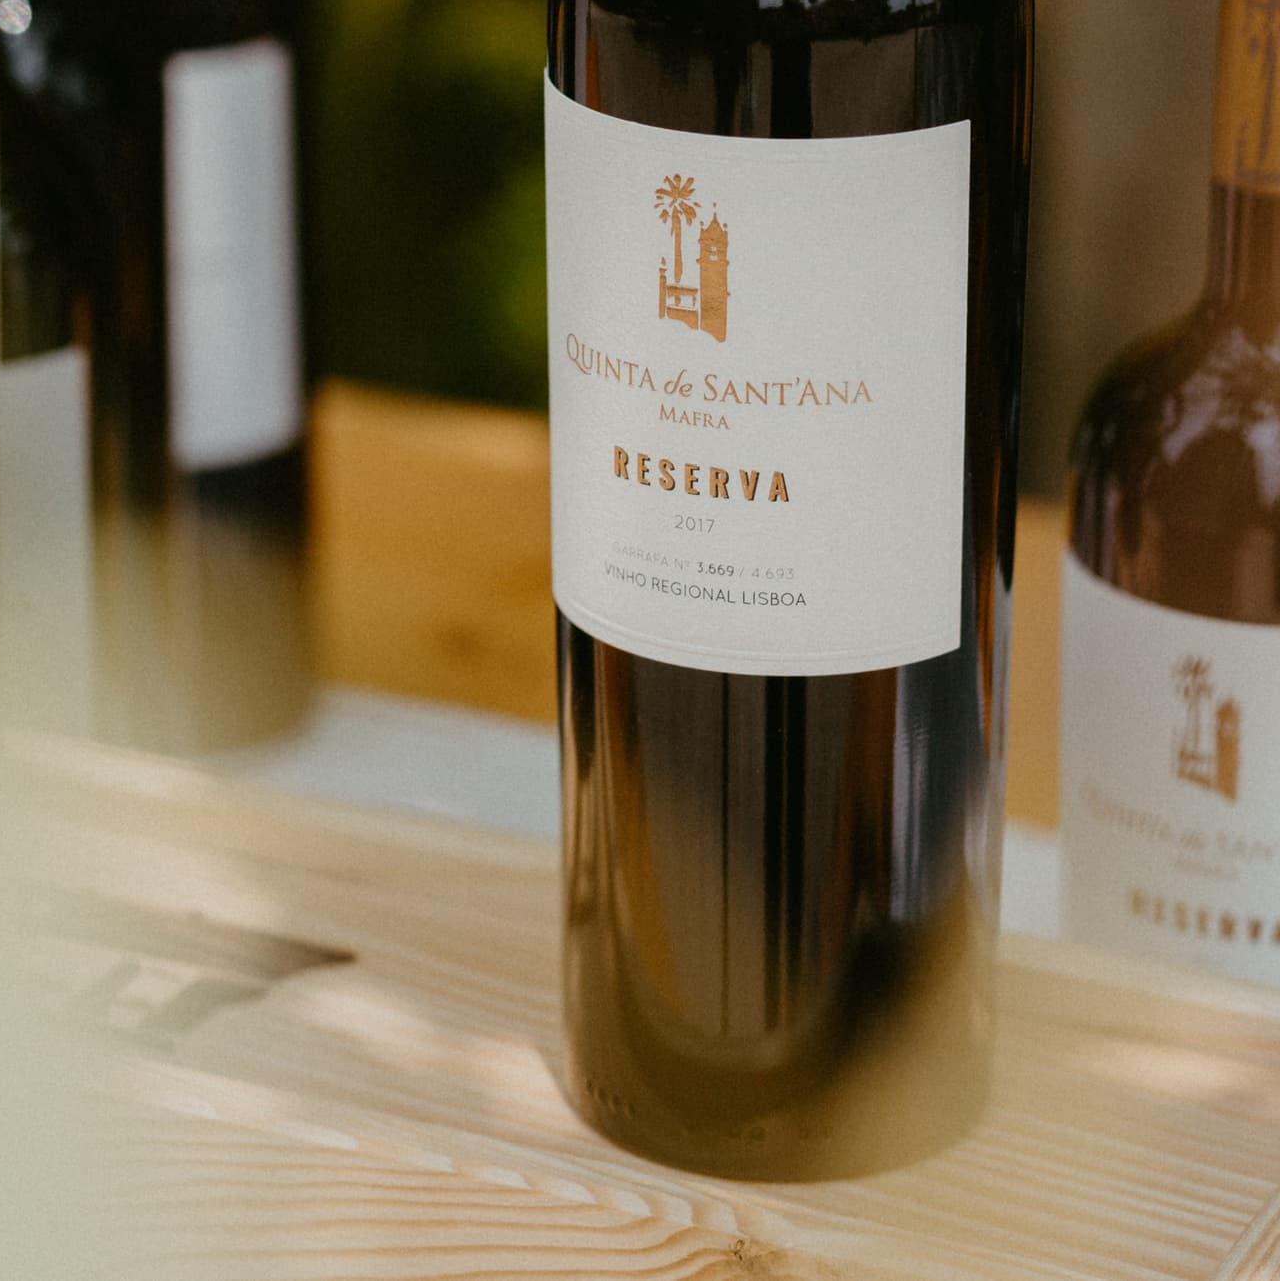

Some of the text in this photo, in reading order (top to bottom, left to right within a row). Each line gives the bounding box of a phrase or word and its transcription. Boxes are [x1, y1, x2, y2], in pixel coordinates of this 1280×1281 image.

[566, 332, 873, 407] QUINTA de SANT'ANA
[658, 403, 730, 430] MAFRA
[613, 445, 790, 503] RESERVA
[674, 514, 716, 534] 2017
[612, 541, 669, 567] GARRAFA
[696, 560, 735, 577] 3.669
[604, 560, 808, 607] VINHO REGIONAL LISBOA
